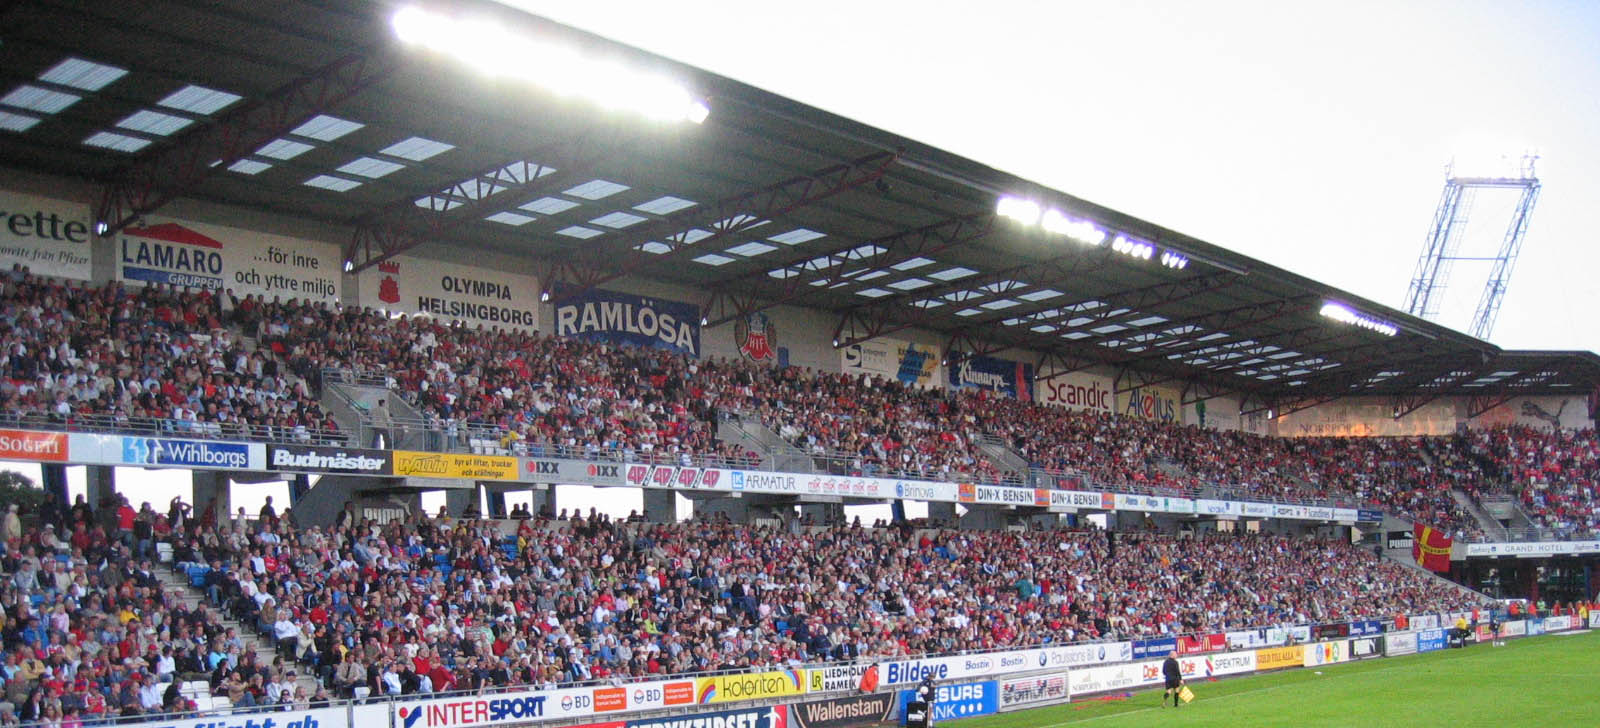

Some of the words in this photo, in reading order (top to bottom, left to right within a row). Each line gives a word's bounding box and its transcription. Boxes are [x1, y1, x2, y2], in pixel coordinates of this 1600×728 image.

[0, 211, 87, 243] ette
[122, 238, 223, 274] LAMARO
[292, 253, 319, 269] inre
[168, 272, 223, 290] GRUPPEN
[235, 269, 260, 287] och
[265, 273, 299, 294] yttre
[301, 275, 336, 299] miljö
[441, 275, 512, 301] OLYMPIA
[418, 296, 534, 327] HELSINGBORG
[557, 299, 696, 354] RAMLÖSA
[1047, 378, 1109, 410] Scandic
[1128, 388, 1175, 421] Akelius
[168, 442, 247, 466] Wihlborgs
[273, 449, 386, 471] Budmäster
[746, 475, 796, 490] ARMATUR
[904, 485, 934, 499] Brinova
[1003, 489, 1033, 503] BENSIN
[1074, 493, 1100, 505] BENSIN
[888, 661, 948, 683] Bildeve
[1214, 655, 1250, 670] SPEKTRUM
[646, 689, 661, 702] BD
[722, 675, 785, 698] koloriten
[426, 696, 546, 727] INTERSPORT
[575, 696, 590, 708] BD
[806, 699, 884, 722] Wallenstam
